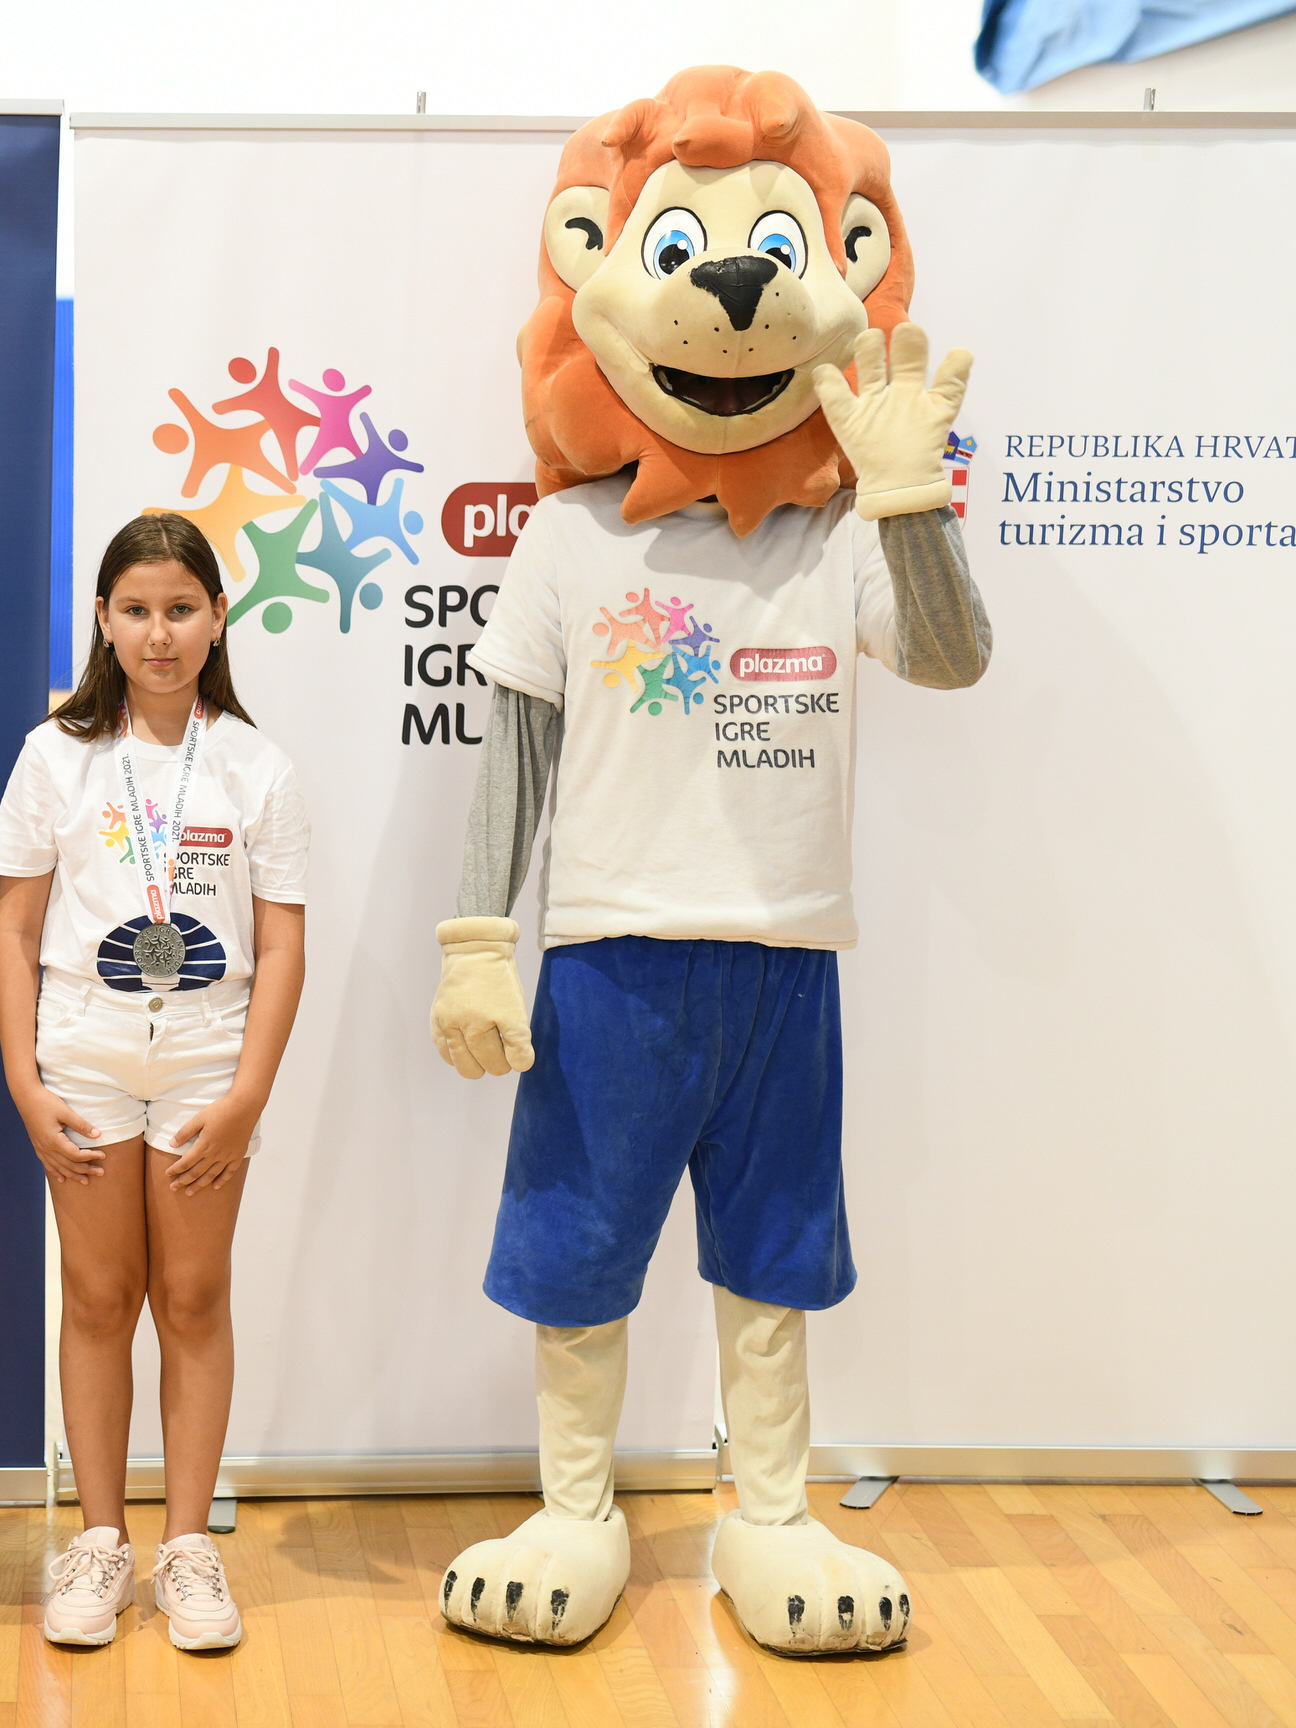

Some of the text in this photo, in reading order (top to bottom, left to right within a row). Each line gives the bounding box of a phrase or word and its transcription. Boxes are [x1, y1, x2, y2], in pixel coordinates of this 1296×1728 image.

[1004, 434, 1185, 458] REPUBLIKA
[1001, 471, 1244, 503] Ministarstvo
[464, 493, 536, 548] pla
[998, 514, 1296, 555] turizma i sporta
[404, 643, 488, 687] IGR
[740, 653, 823, 677] plazma
[713, 692, 840, 715] SPORTSKE
[185, 720, 200, 763] SPORTSKE
[715, 721, 771, 742] IGRE
[180, 763, 192, 782] IGRE
[717, 748, 815, 769] MLADIH
[125, 777, 139, 812] MLADIH
[174, 784, 188, 818] MLADIH
[133, 813, 144, 835] IGRE
[138, 836, 155, 882] SPORTSKE
[164, 851, 231, 867] ORTSKE
